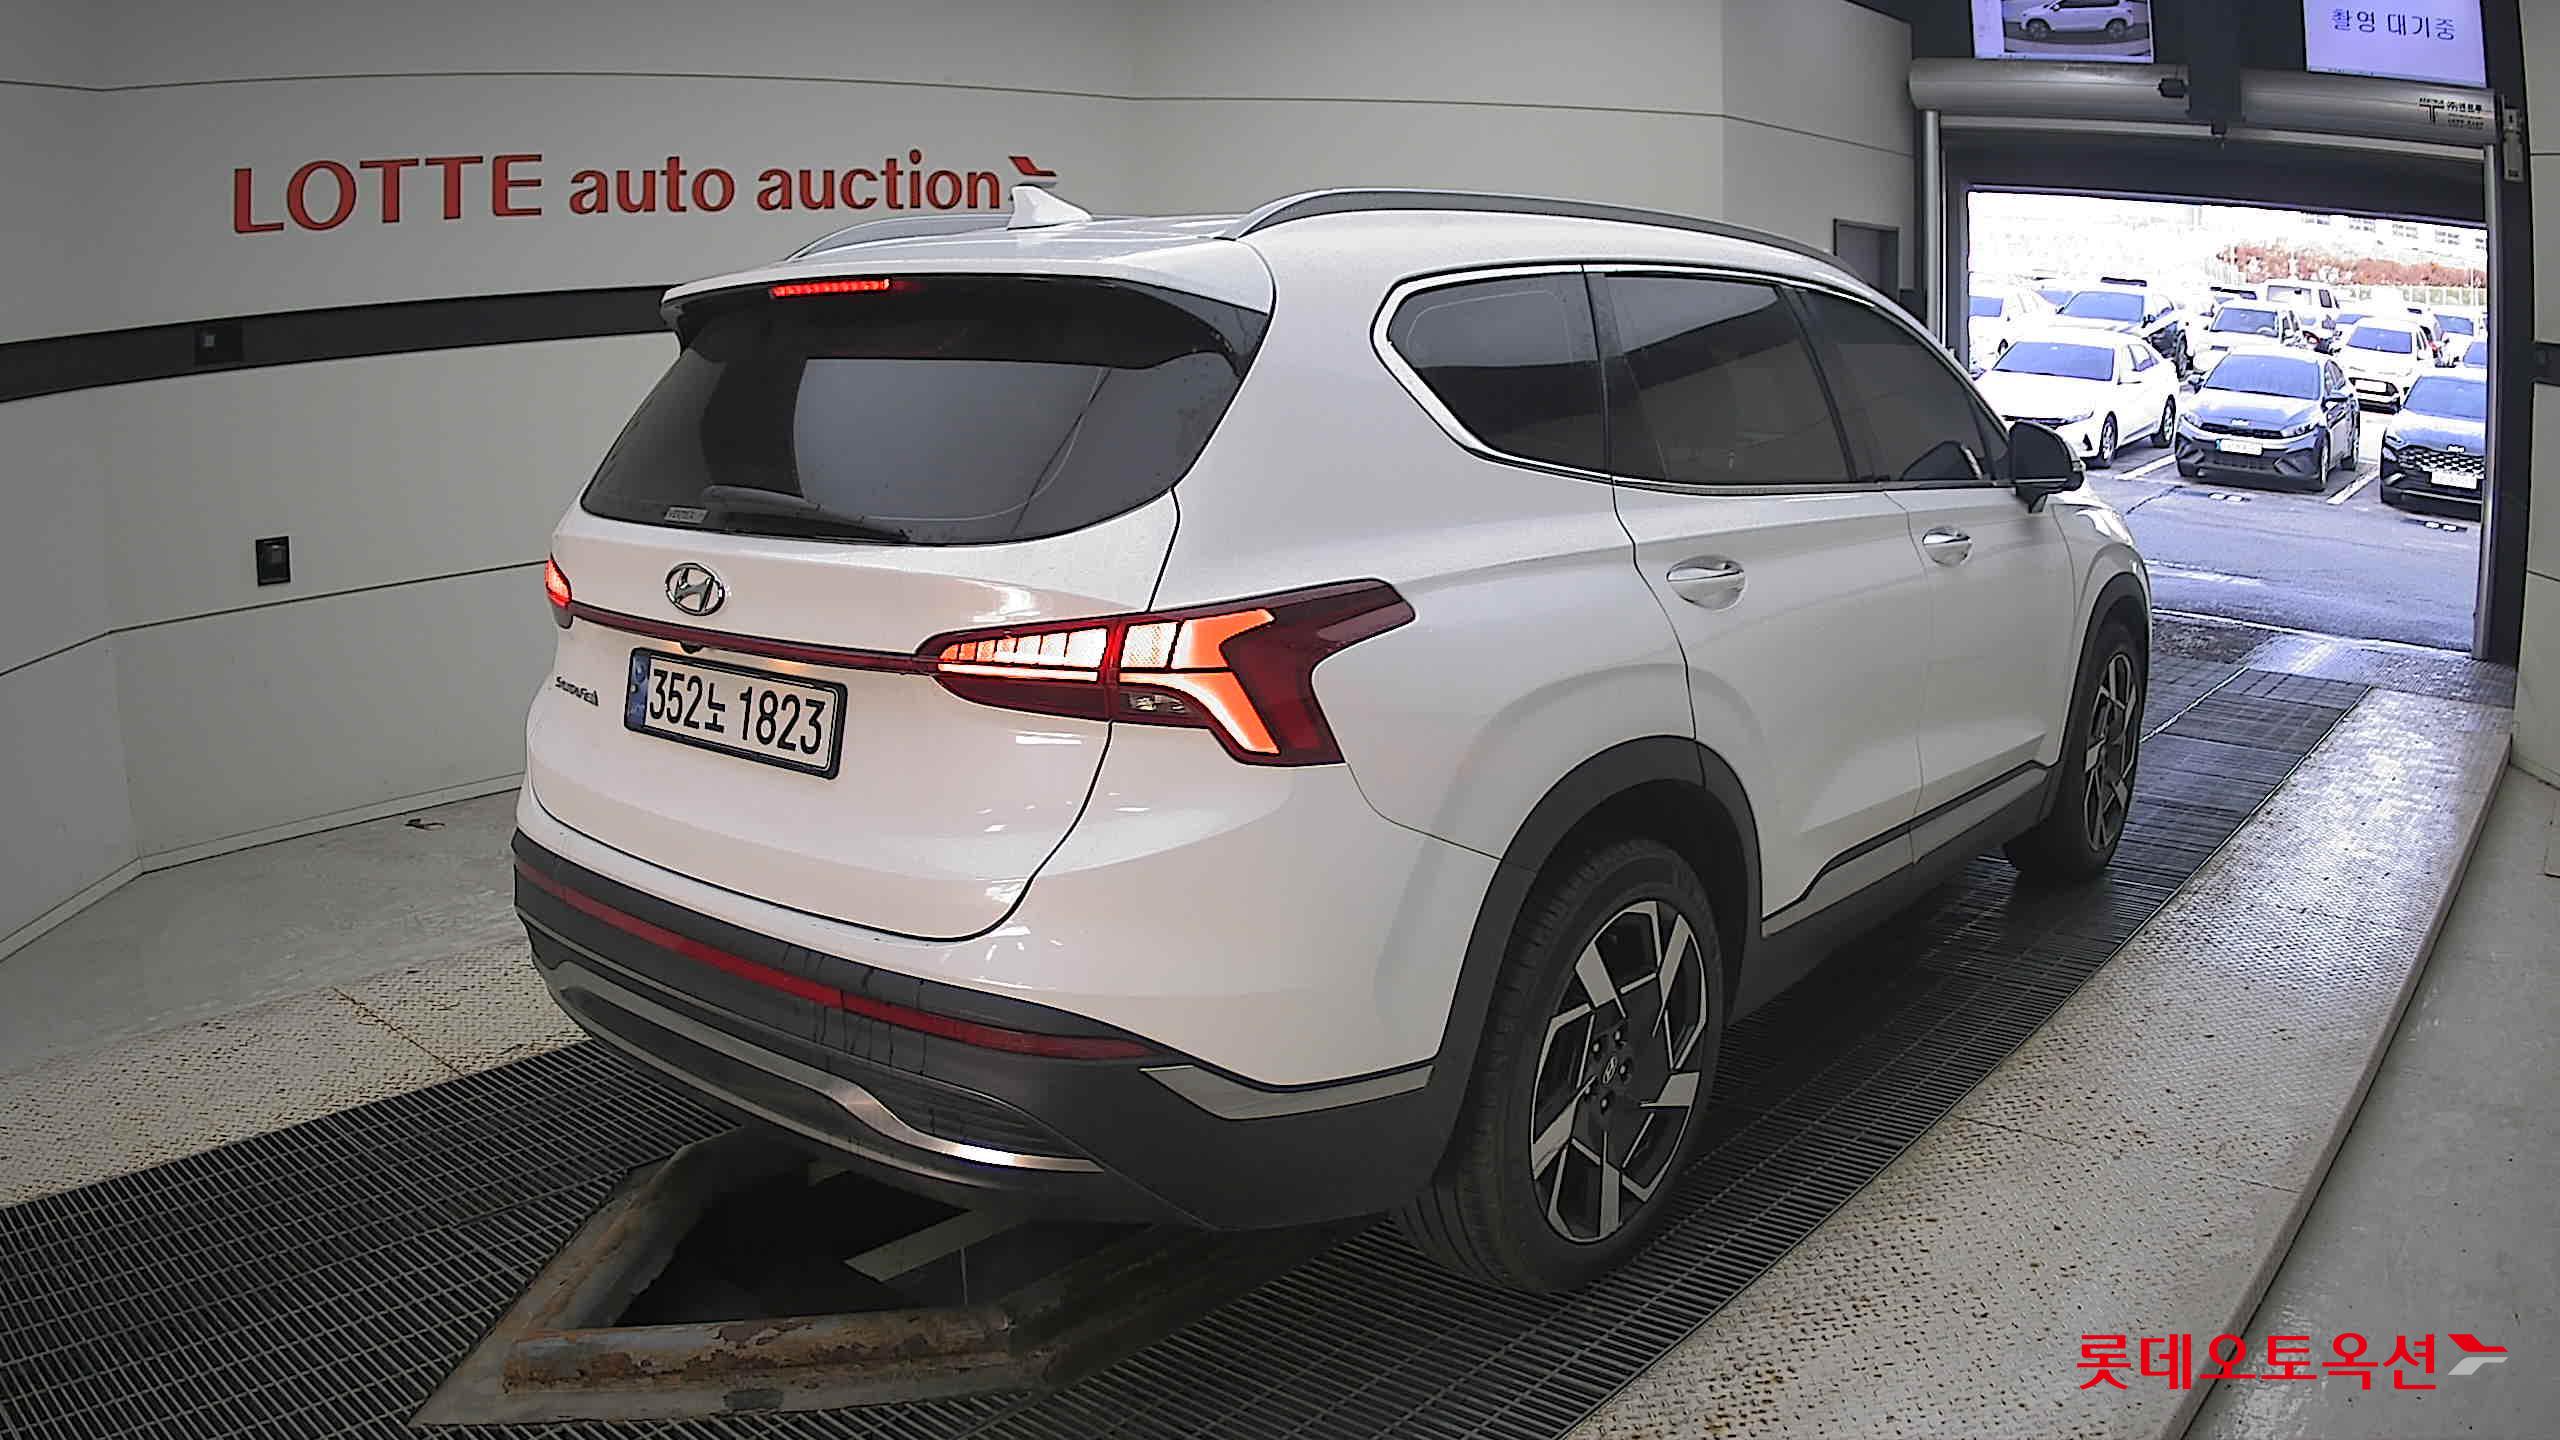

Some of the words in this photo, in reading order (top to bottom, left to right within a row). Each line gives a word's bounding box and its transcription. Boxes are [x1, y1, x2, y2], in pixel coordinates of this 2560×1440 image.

[2330, 9, 2376, 33] 촬영
[2387, 14, 2455, 40] 대기중
[233, 154, 543, 233] LOTTE
[569, 156, 736, 213] auto
[756, 149, 1001, 211] auction
[650, 669, 726, 732] 352노
[740, 686, 826, 755] 1823
